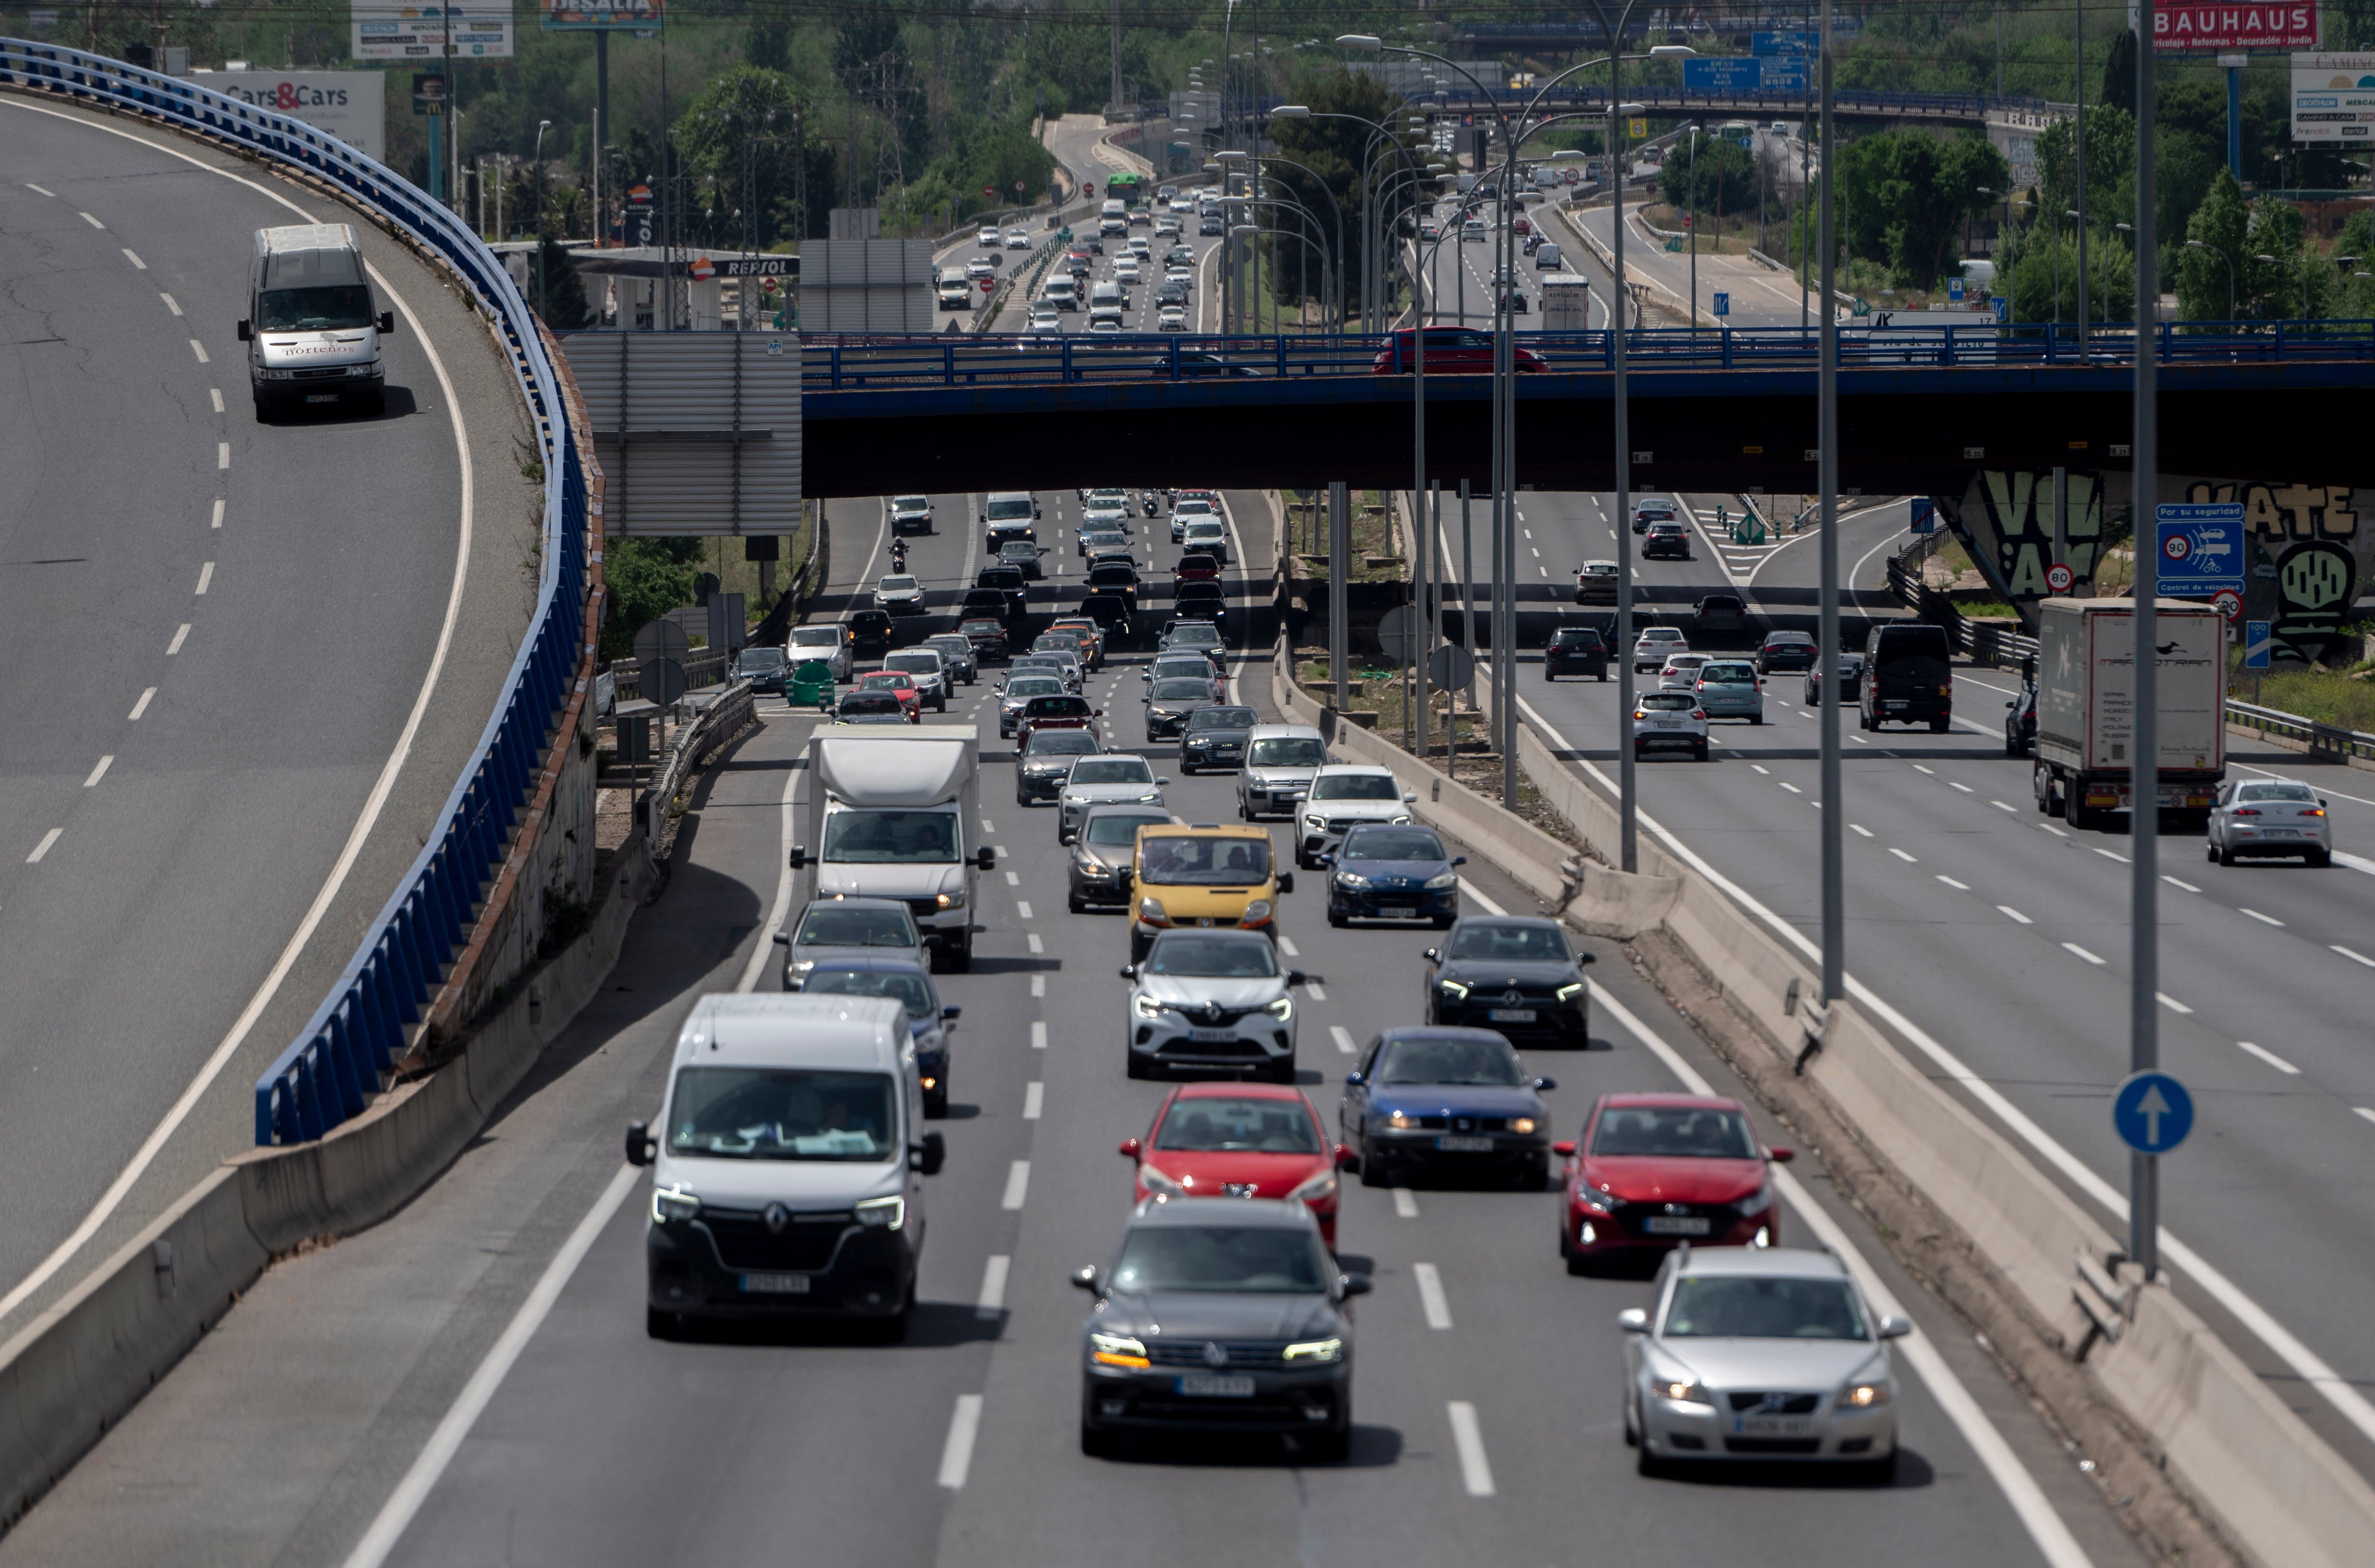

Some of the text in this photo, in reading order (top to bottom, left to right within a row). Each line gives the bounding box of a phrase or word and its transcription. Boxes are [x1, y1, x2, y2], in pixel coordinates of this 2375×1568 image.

[2154, 9, 2308, 33] BAUHAUS
[2154, 35, 2312, 47] ricolaje Reformas Decoración Jardín
[729, 261, 786, 274] REPSOL
[285, 345, 354, 356] norteños
[2195, 507, 2240, 516] seguridad
[2169, 543, 2185, 552] 90
[2052, 573, 2068, 583] 80
